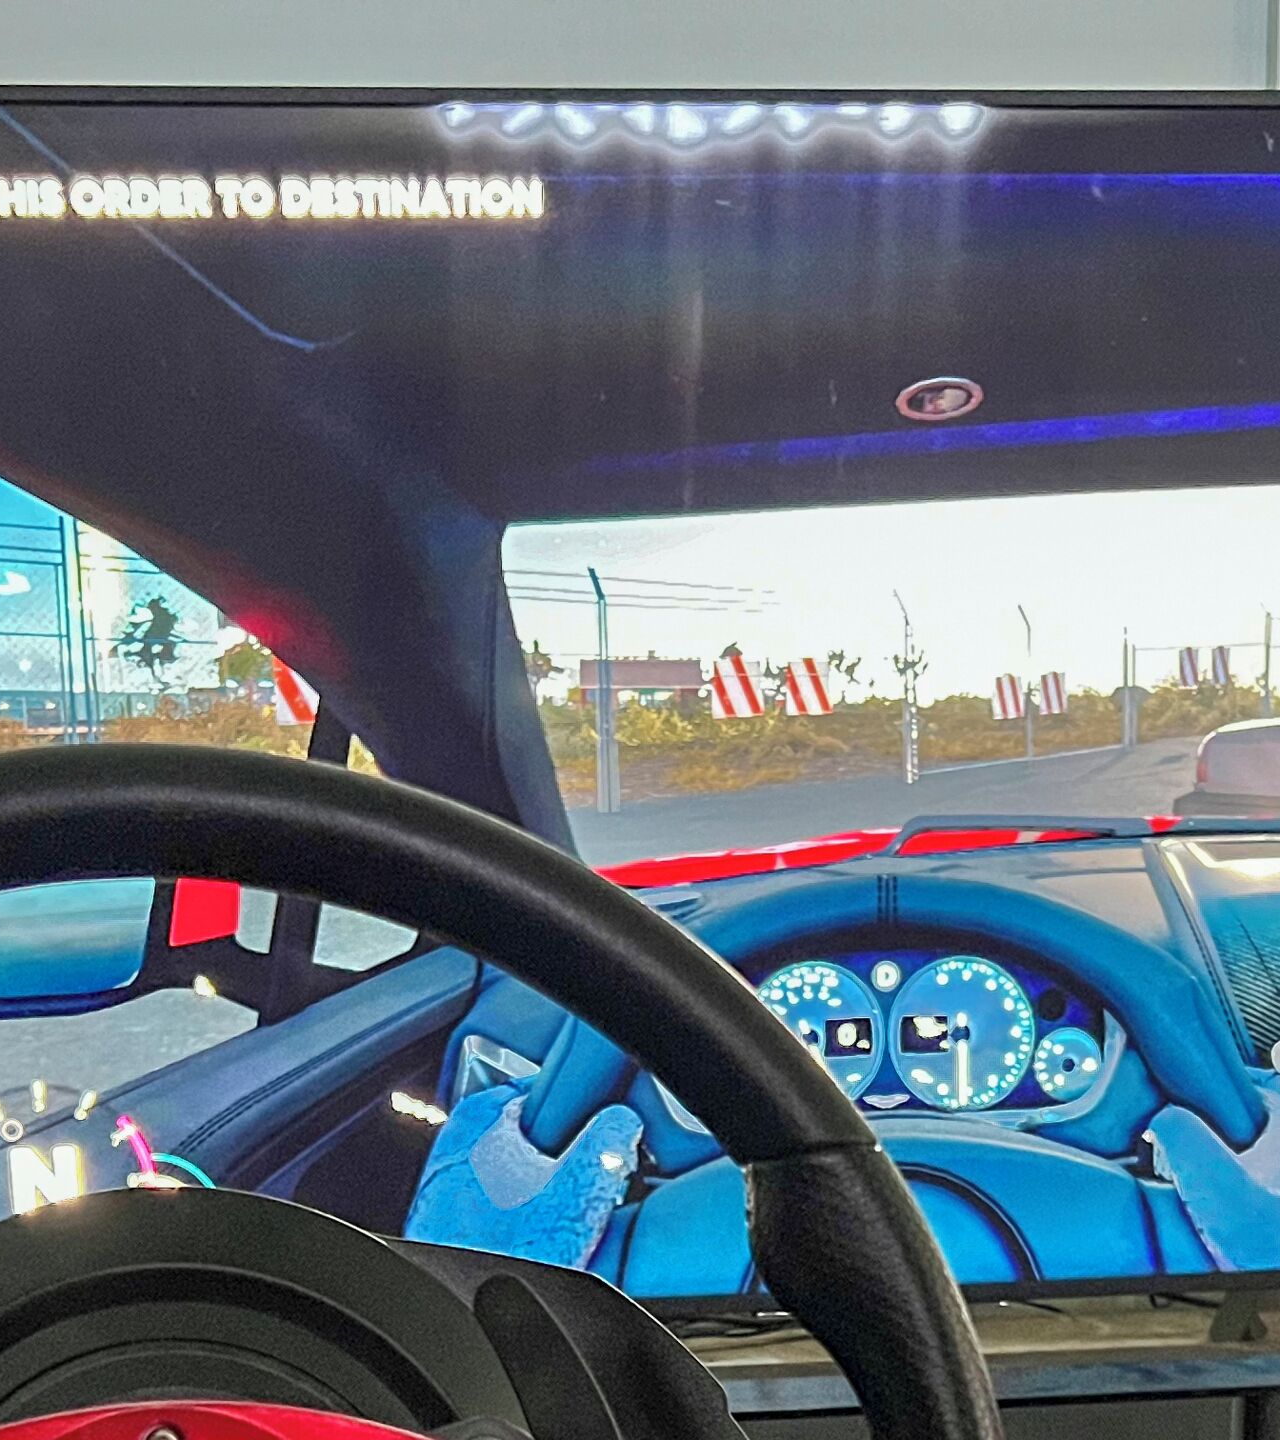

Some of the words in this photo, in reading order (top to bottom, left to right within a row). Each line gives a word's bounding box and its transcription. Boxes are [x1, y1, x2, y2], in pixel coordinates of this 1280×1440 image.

[70, 179, 213, 218] ORDER
[215, 179, 276, 218] TO
[280, 179, 544, 218] DESTINATION
